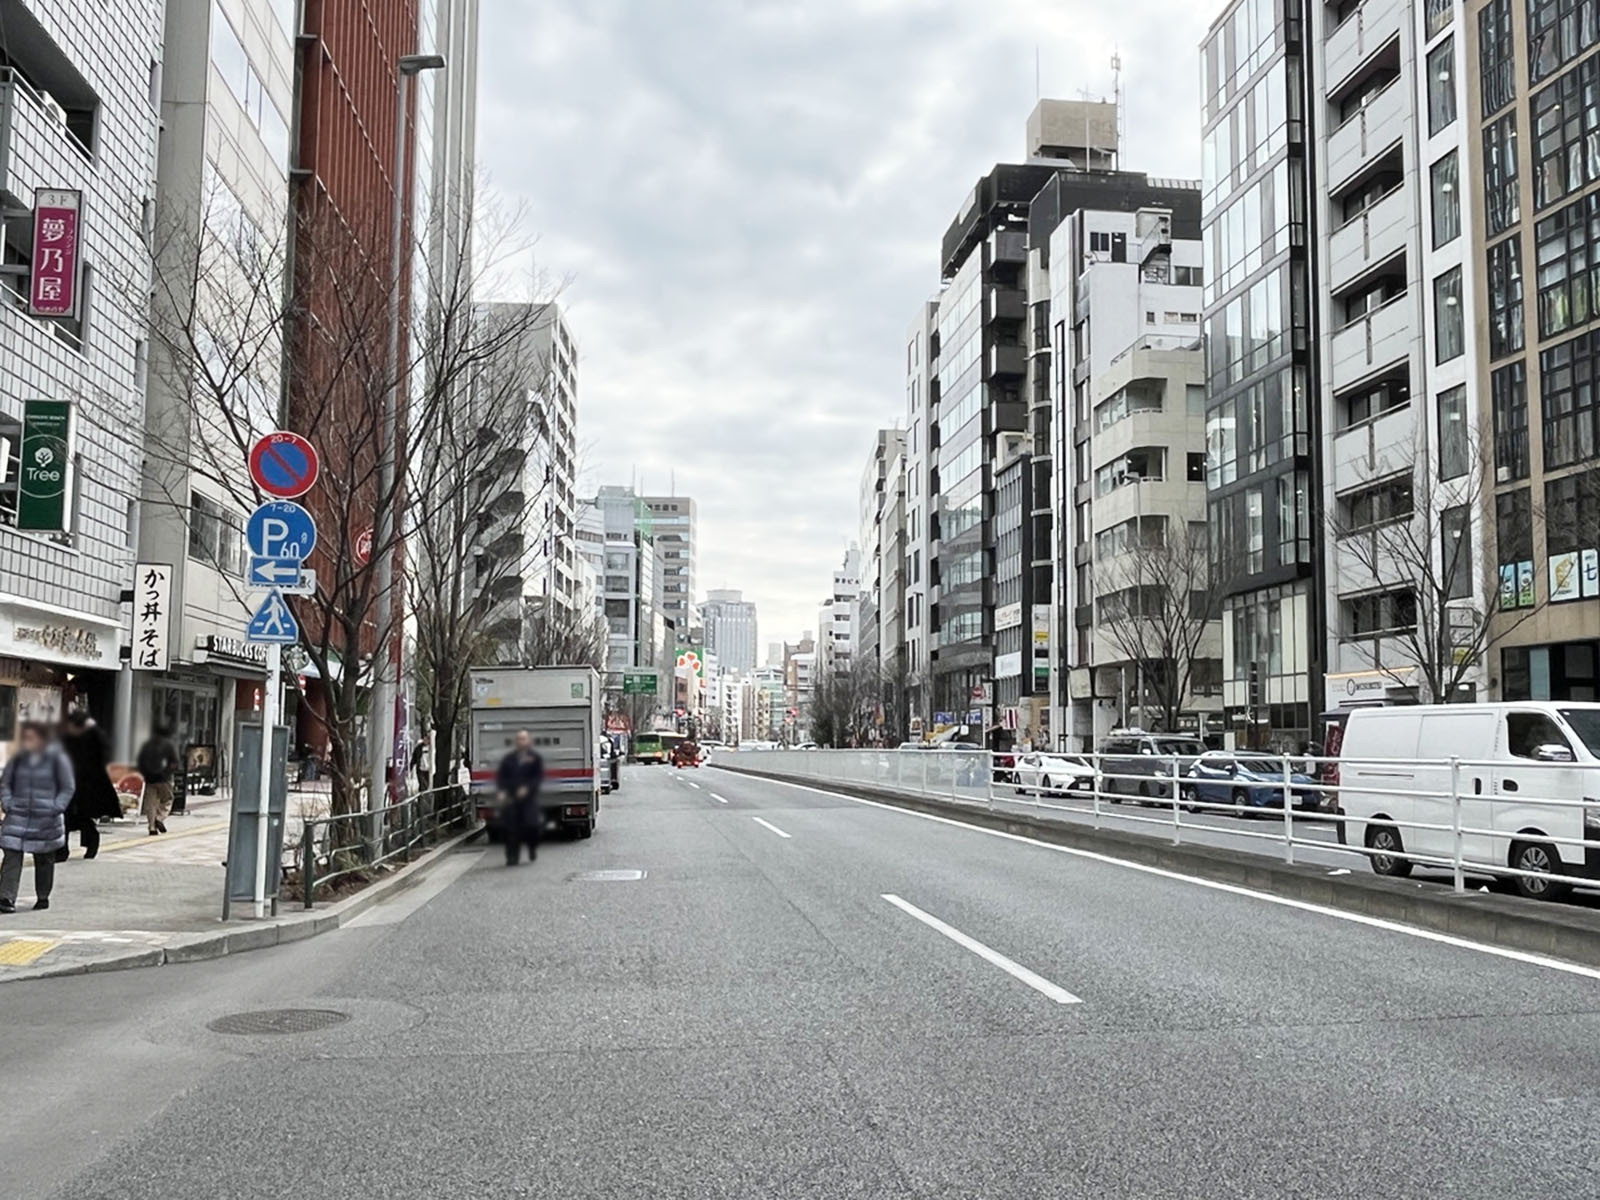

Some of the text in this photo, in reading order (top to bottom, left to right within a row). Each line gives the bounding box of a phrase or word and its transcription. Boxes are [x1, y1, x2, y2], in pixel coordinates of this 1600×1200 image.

[38, 218, 65, 300] 夢乃屋
[270, 435, 297, 444] 20-7
[26, 467, 60, 481] Tree
[270, 503, 297, 513] 7-20
[262, 518, 289, 557] P
